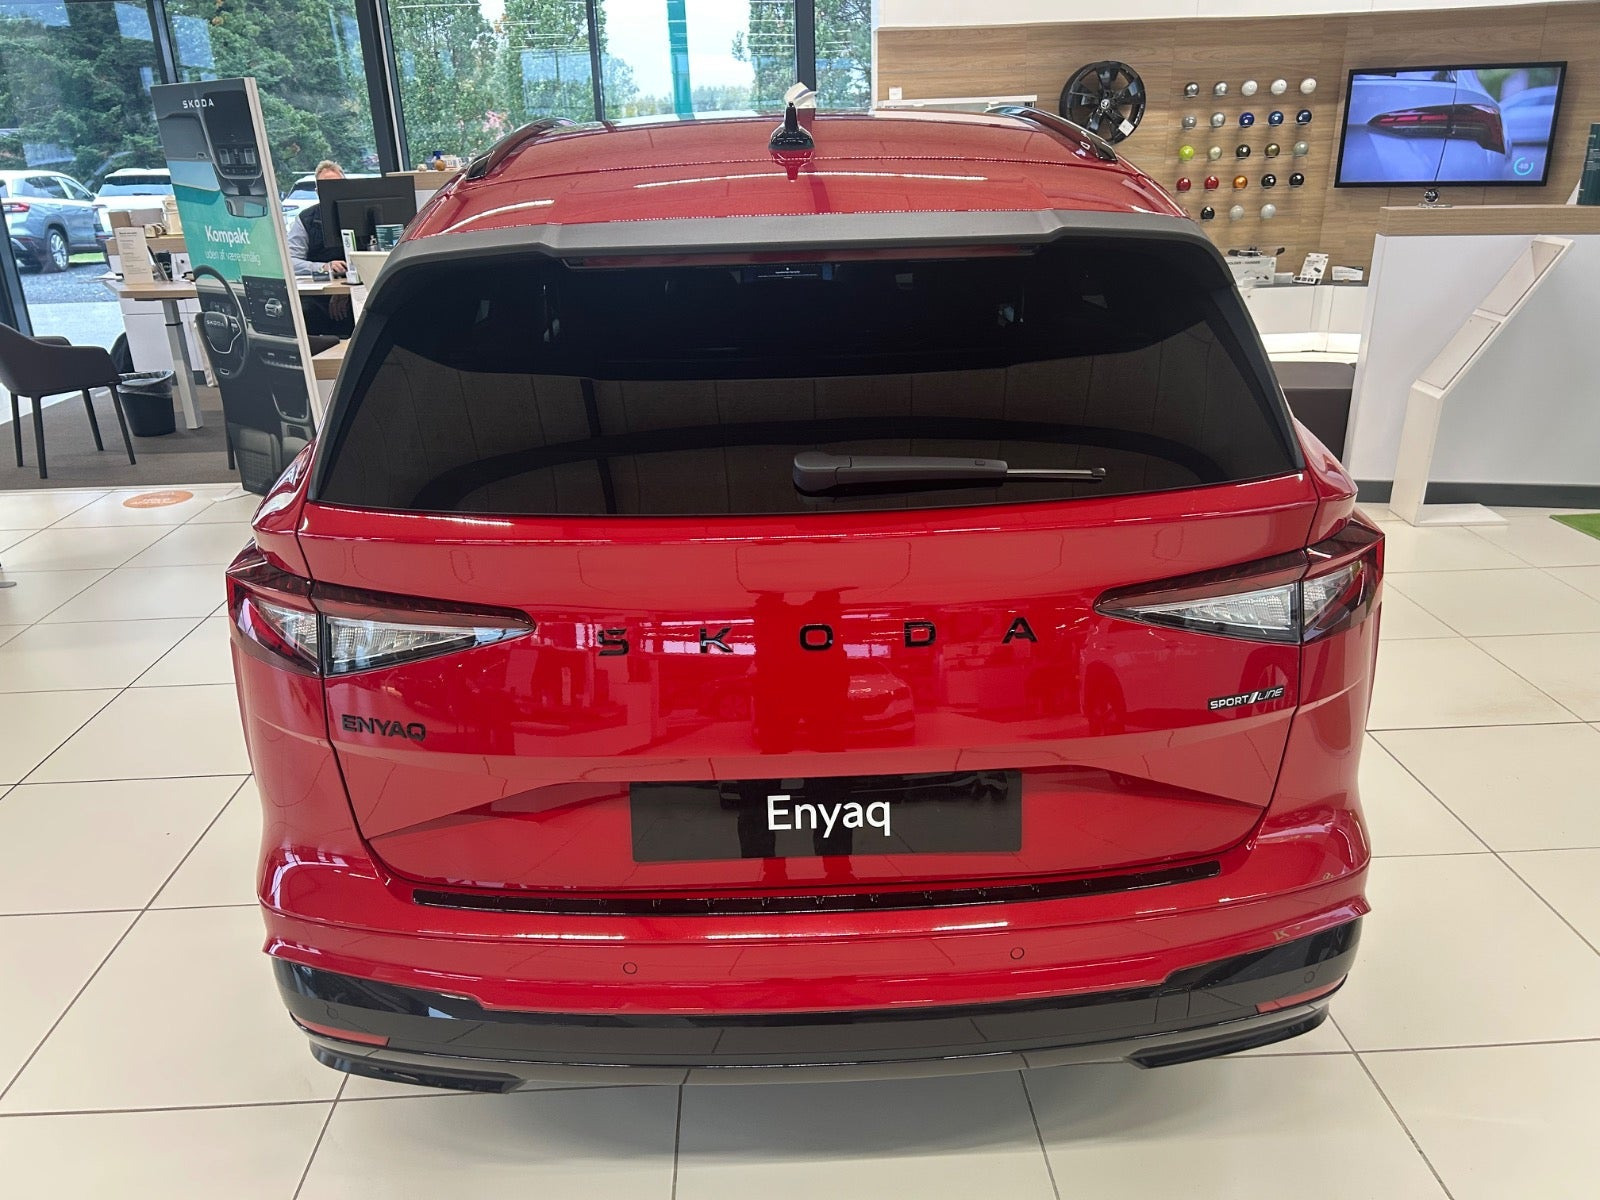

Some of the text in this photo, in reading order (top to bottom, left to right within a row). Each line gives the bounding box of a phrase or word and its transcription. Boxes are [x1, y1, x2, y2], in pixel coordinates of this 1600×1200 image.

[182, 98, 215, 109] SKODA
[204, 225, 251, 247] Kompakt
[597, 617, 1038, 656] SKODA
[341, 714, 426, 741] ENYAQ
[767, 795, 891, 838] Enyaq
